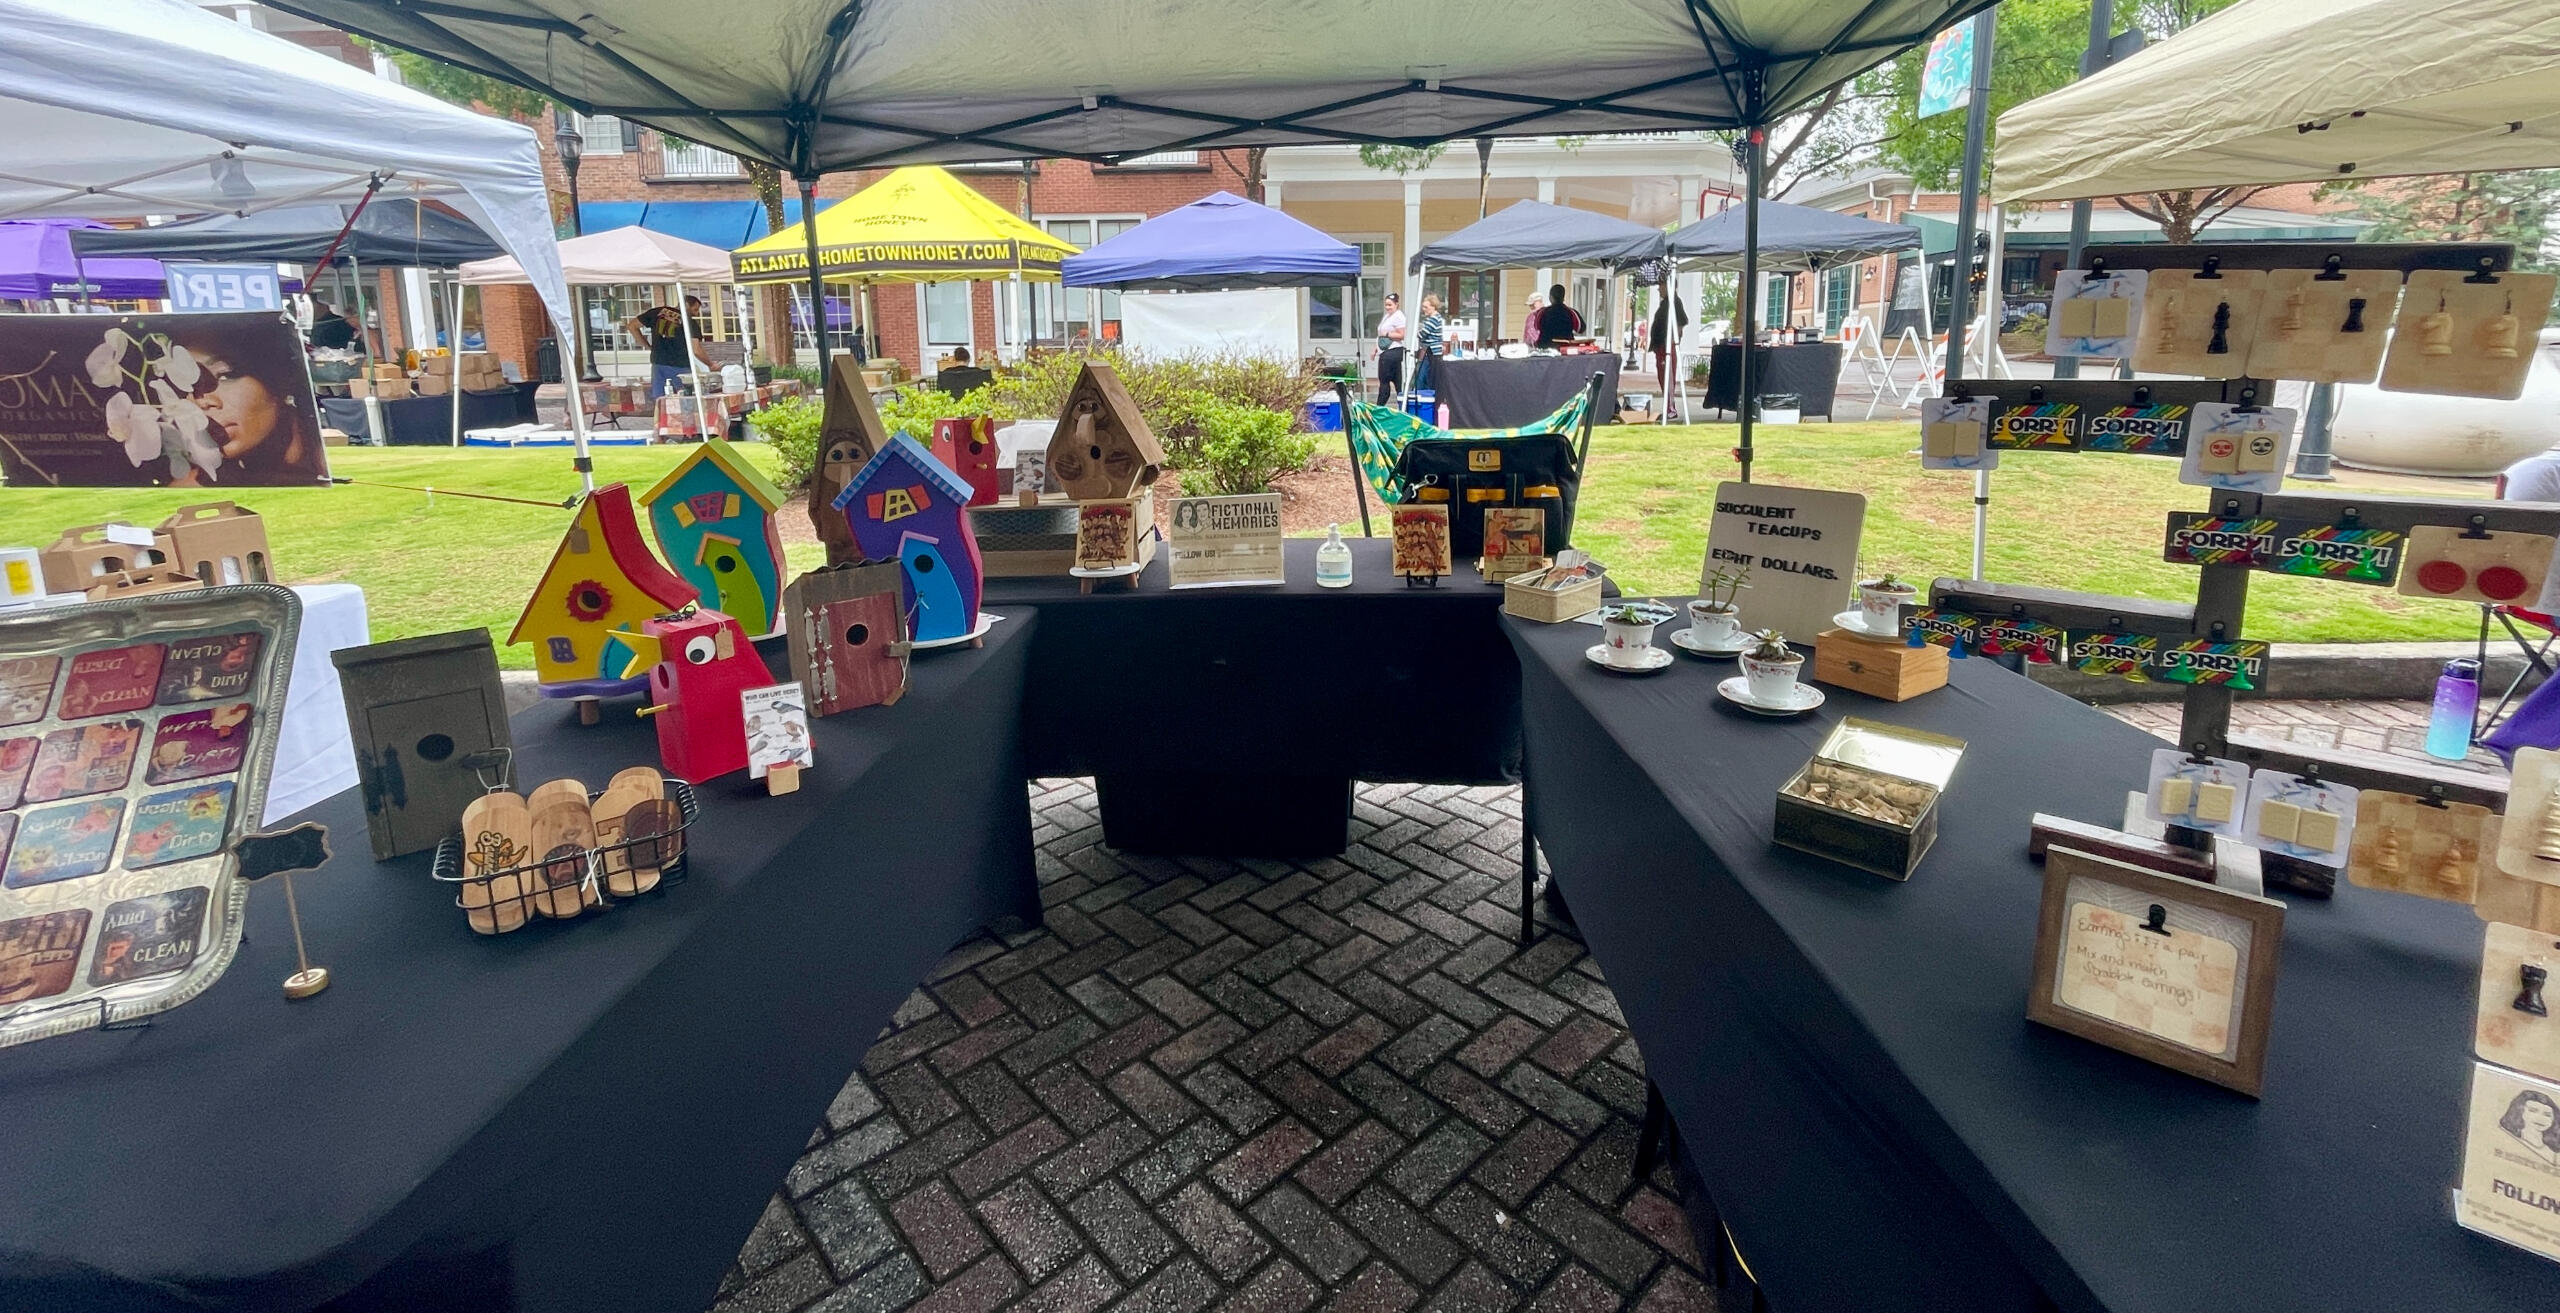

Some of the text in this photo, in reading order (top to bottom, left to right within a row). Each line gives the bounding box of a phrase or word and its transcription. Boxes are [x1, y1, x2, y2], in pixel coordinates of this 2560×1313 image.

[740, 243, 1010, 273] ATLANTAHOMETOWNHONEY.COM
[51, 282, 101, 292] Acadmy
[1211, 502, 1278, 517] FICTIONAL
[1716, 502, 1796, 519] SUCCULENT
[1212, 514, 1279, 531] MEMORIES
[1747, 521, 1822, 541] TEACUPS
[1760, 557, 1839, 581] DOLLARS.
[2074, 642, 2155, 666] SORRY
[168, 830, 218, 850] Dirty
[133, 939, 192, 963] CLEAN
[2076, 944, 2097, 959] Mix
[2101, 952, 2124, 966] and
[2178, 947, 2208, 963] pair
